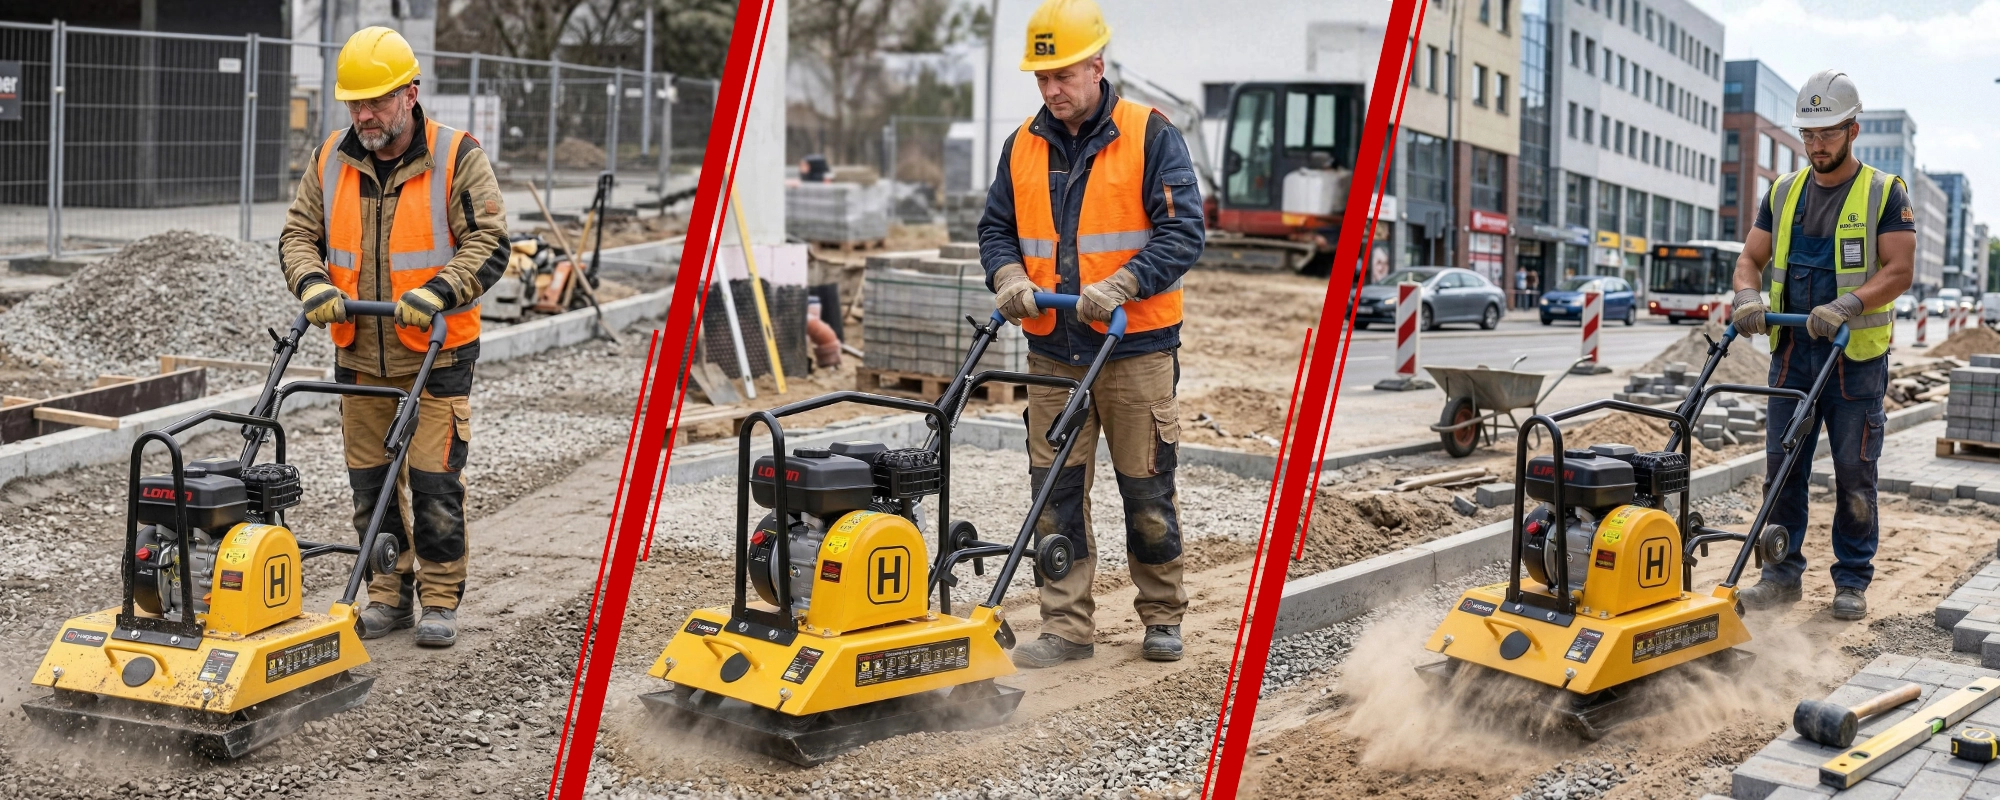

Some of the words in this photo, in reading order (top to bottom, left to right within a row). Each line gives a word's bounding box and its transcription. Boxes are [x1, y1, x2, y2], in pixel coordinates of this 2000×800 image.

[878, 556, 901, 595] H
[1646, 545, 1664, 580] H
[270, 563, 285, 599] H
